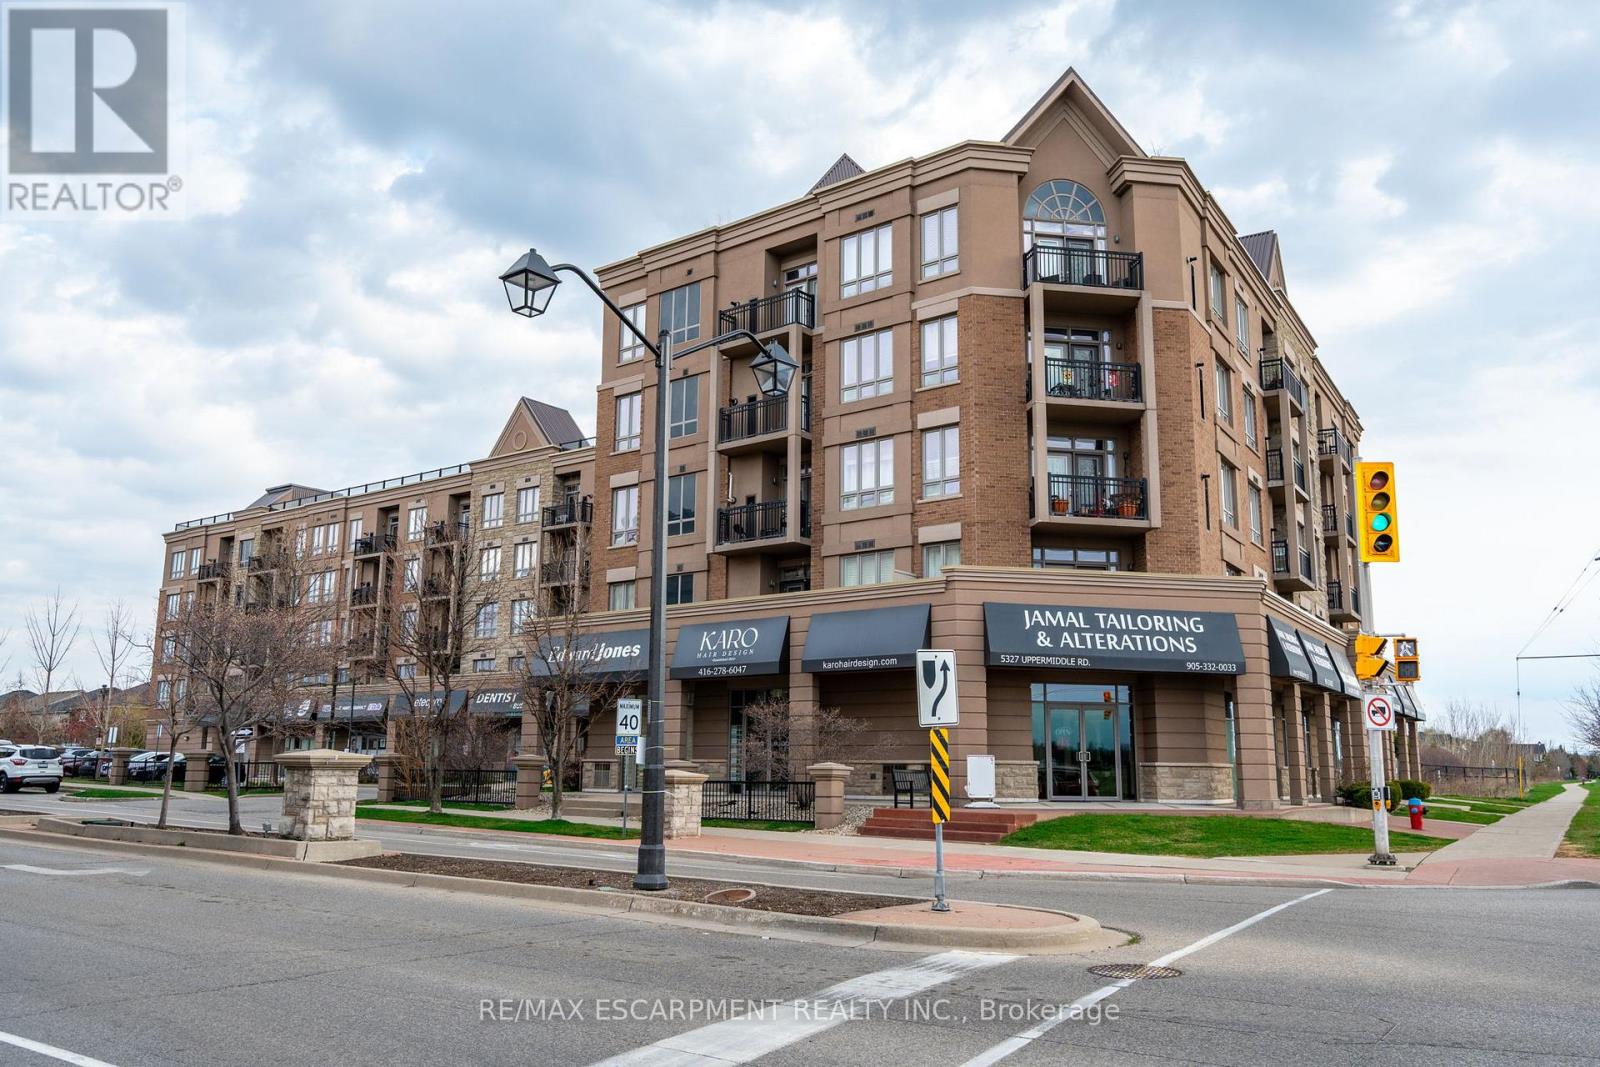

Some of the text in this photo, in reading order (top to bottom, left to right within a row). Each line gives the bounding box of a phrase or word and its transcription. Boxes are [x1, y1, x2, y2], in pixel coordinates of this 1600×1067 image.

[1023, 609, 1205, 633] JAMAL TAILORING
[699, 627, 759, 652] KARO
[1036, 630, 1197, 653] & ALTERATIONS
[696, 648, 754, 659] HAIR DESIGN
[822, 656, 898, 670] karohairdesign.com
[1000, 654, 1091, 667] 5327 UPPERMIDDLE RD.
[698, 665, 747, 677] 416-278-6047
[1186, 662, 1237, 673] 905-332-0033
[475, 692, 519, 705] DENTIST
[619, 714, 639, 731] 40
